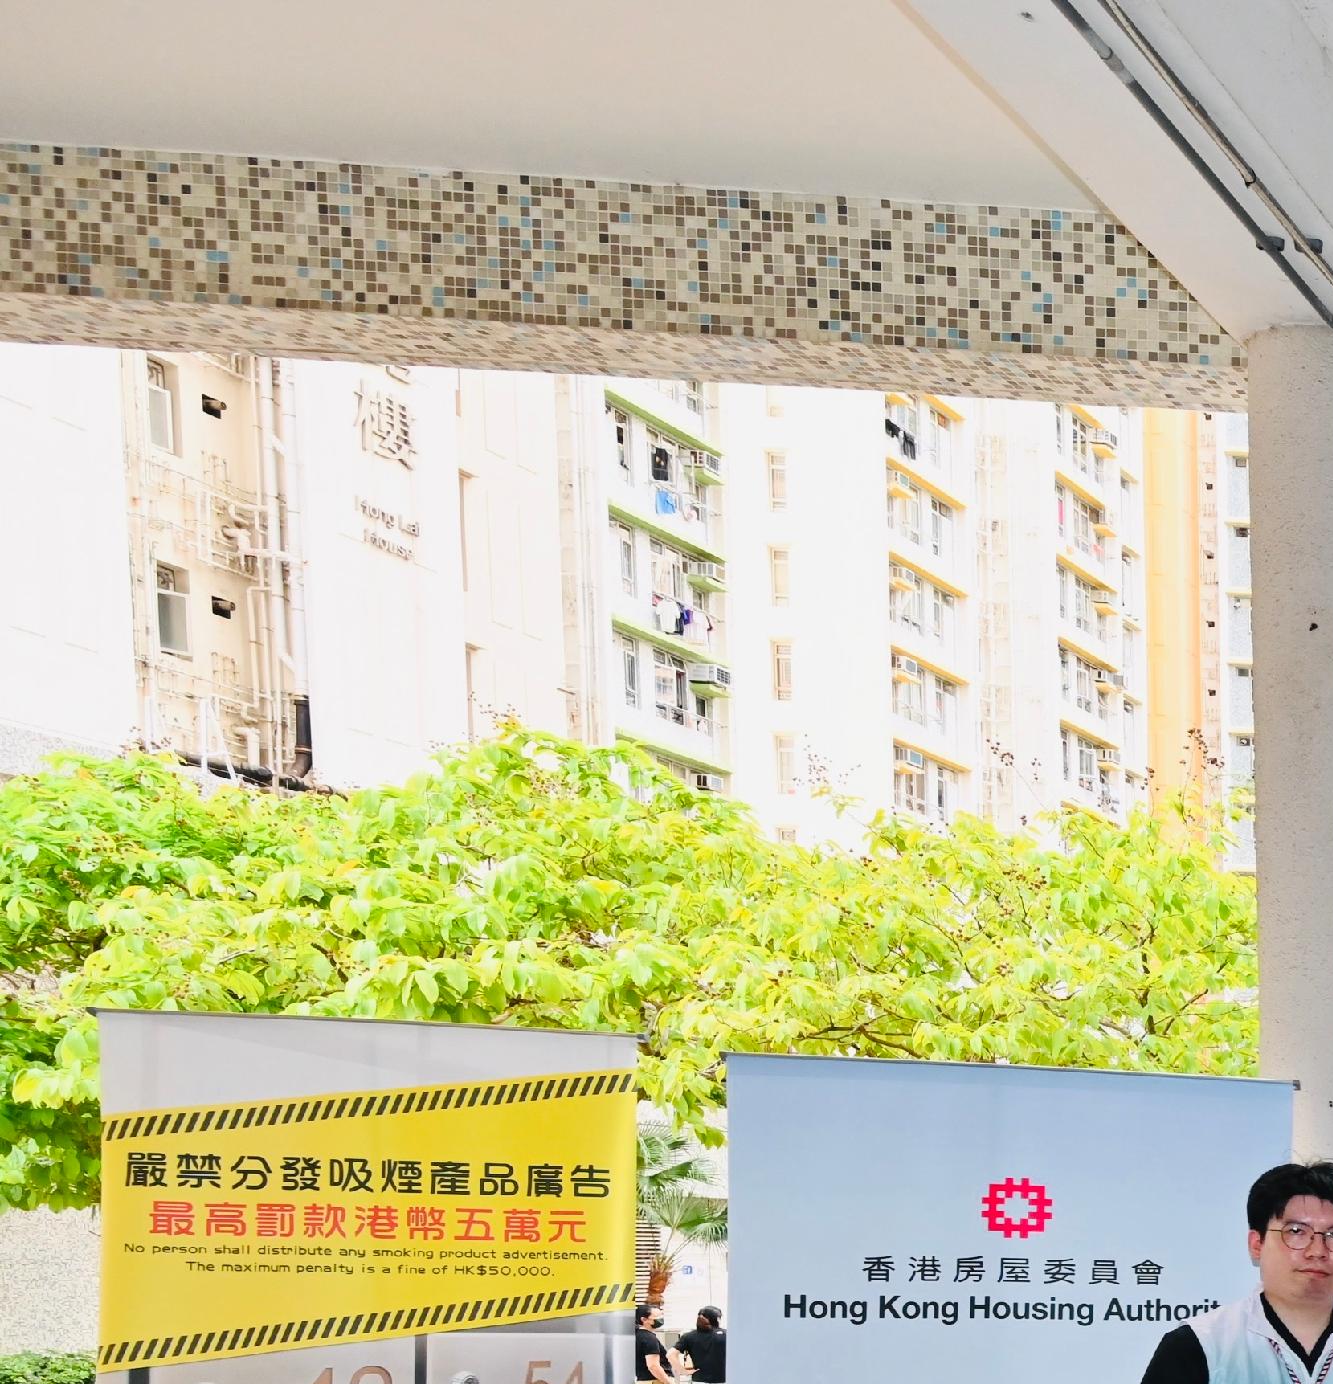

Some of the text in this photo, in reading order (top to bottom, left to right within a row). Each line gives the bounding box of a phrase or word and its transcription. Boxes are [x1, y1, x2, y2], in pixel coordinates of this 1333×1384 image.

[353, 366, 418, 471] 樓
[124, 1150, 613, 1200] 嚴禁分發吸煙產品廣告
[148, 1199, 590, 1245] 最高罰款港幣五萬元
[124, 1242, 609, 1262] No person shall distribute any smoking product advertisement.
[186, 1260, 556, 1279] The maximum penalty is a fine of HK$50,000.
[862, 1255, 1166, 1287] 香港房屋委員會
[783, 1293, 1222, 1327] Hong Kong Housing Authori
